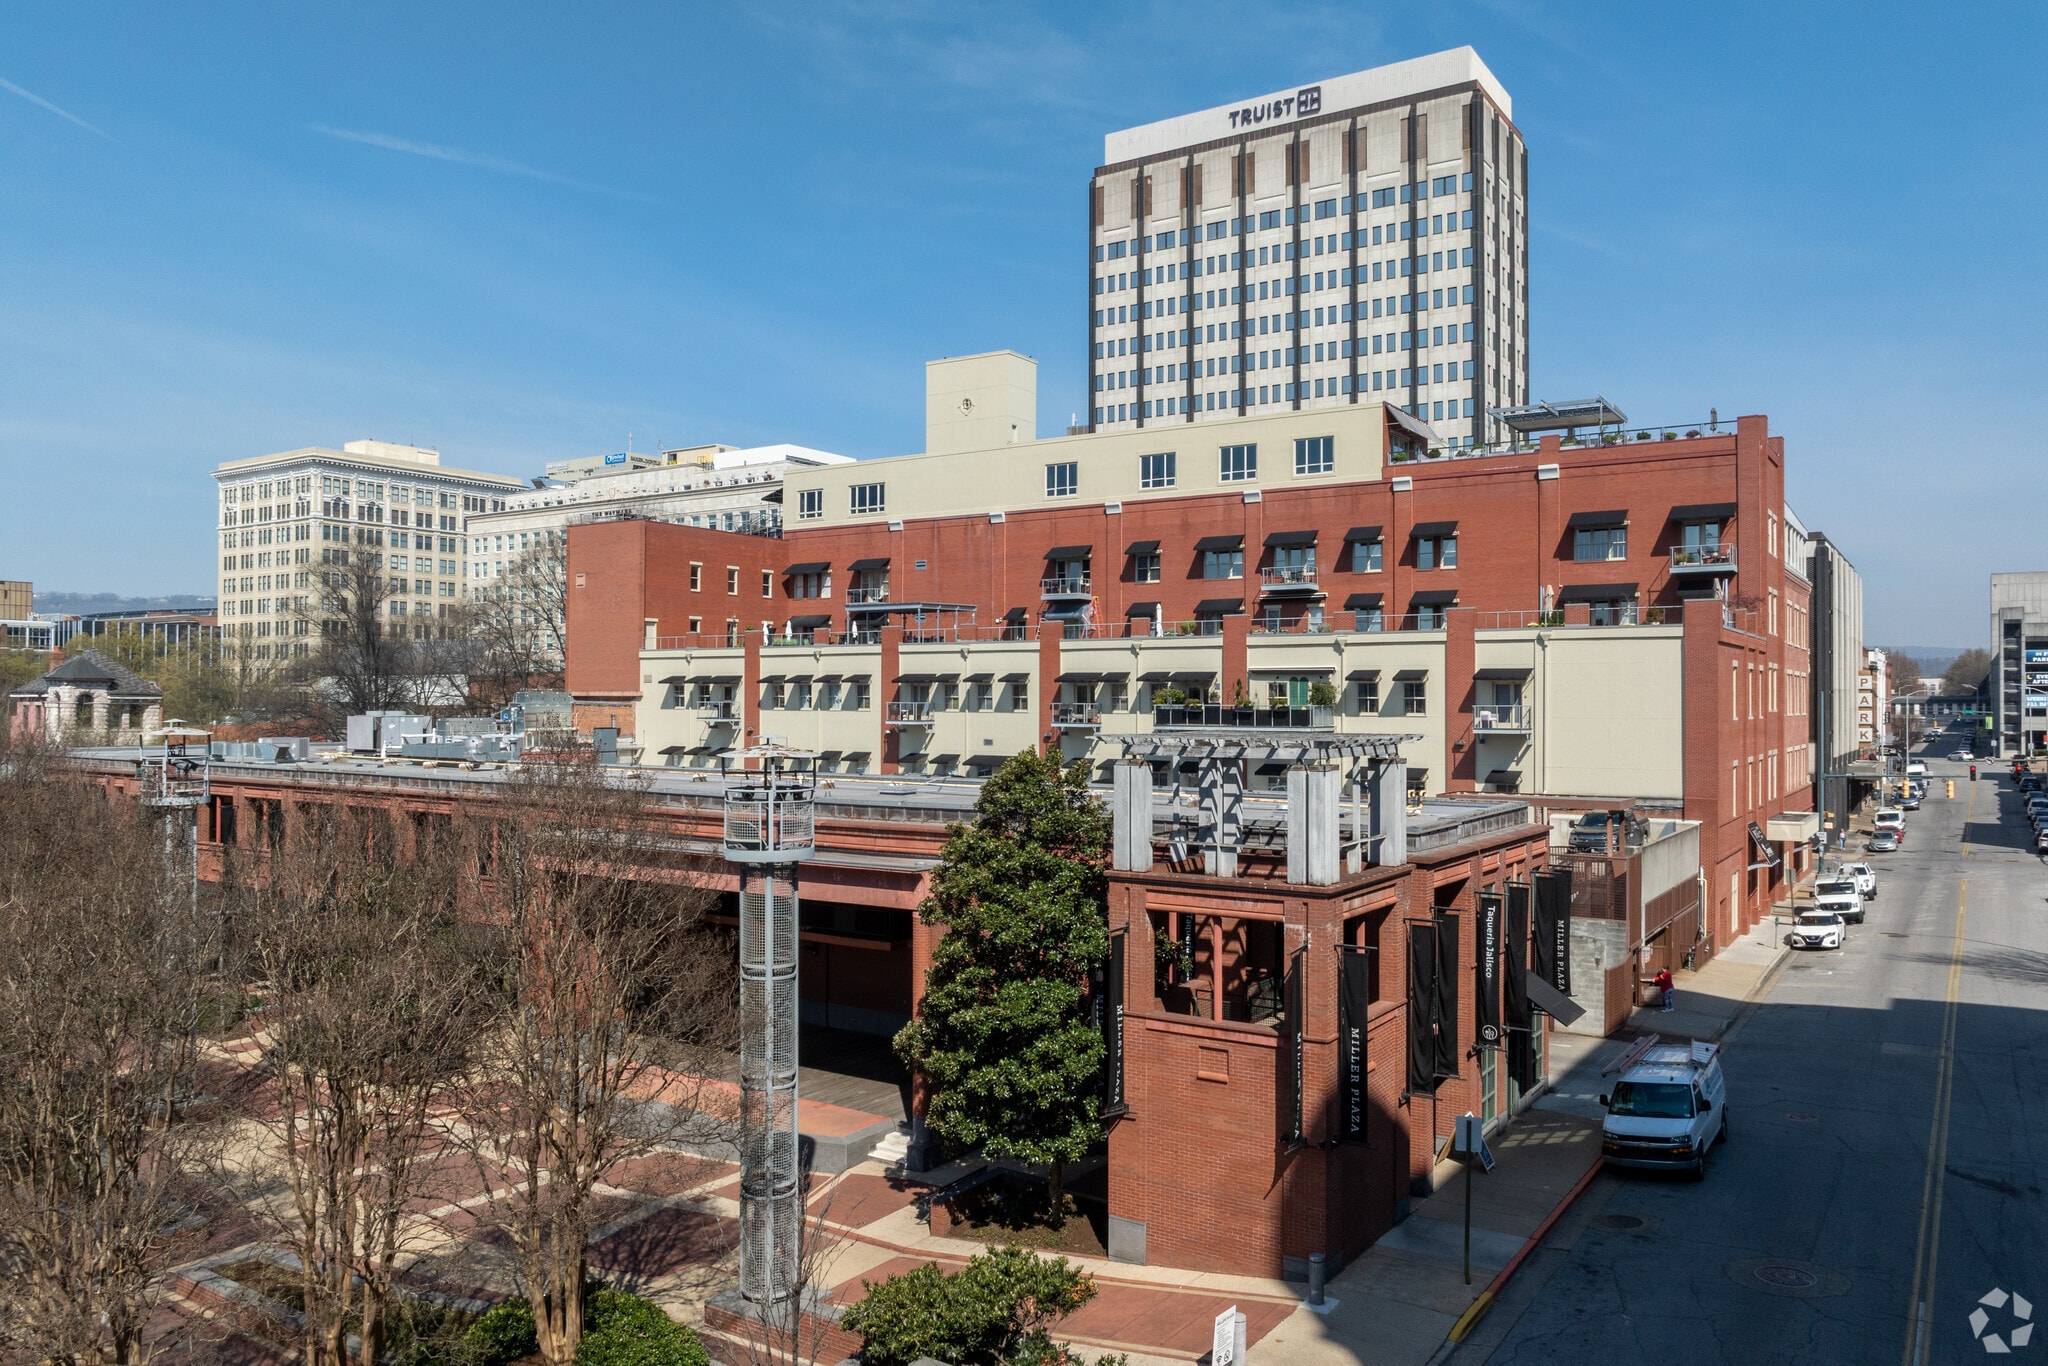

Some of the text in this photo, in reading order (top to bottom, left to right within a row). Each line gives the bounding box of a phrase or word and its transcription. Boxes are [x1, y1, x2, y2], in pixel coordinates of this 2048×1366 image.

[1228, 97, 1295, 129] TRUIST
[1860, 678, 1869, 740] PARK
[1485, 946, 1494, 978] Jalisco
[1557, 919, 1565, 990] MILLER PLAZA
[1351, 1027, 1360, 1133] MILLER PLAZA
